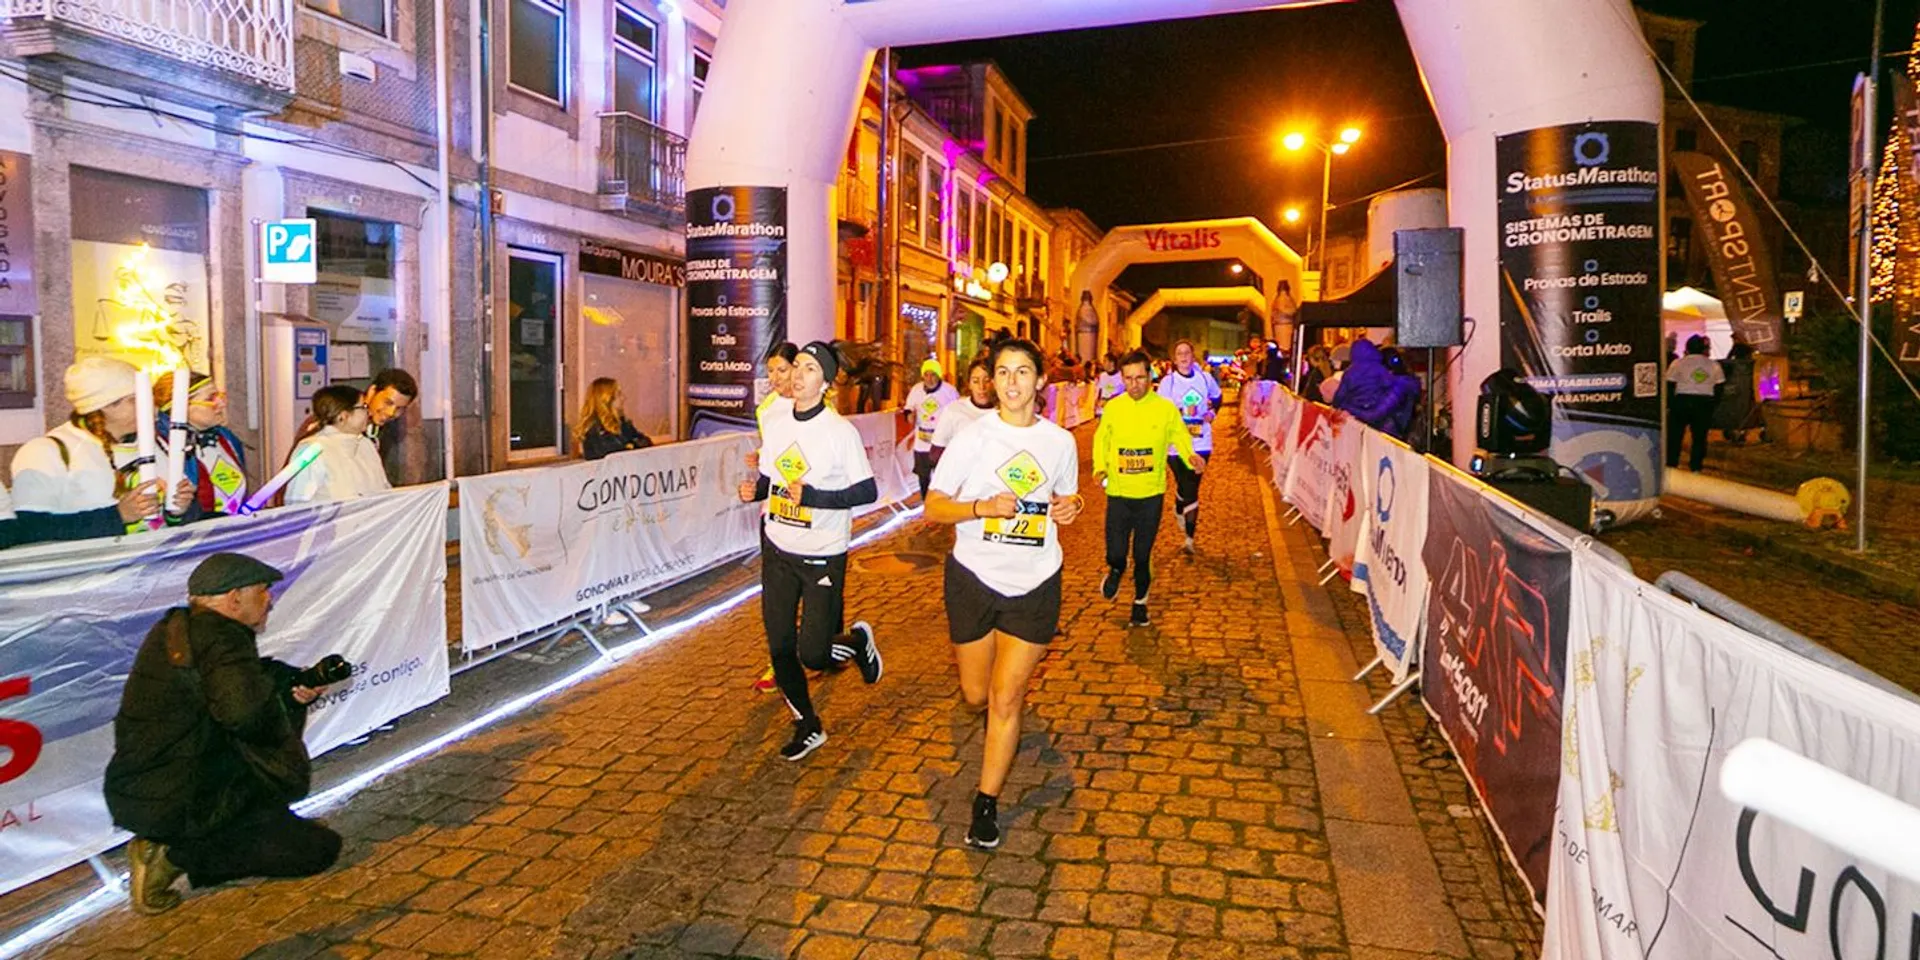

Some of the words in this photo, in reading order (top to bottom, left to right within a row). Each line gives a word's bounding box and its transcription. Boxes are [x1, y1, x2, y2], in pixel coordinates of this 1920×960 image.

[1505, 166, 1658, 194] StatusMarathon
[686, 221, 785, 239] StatusMarathon
[1505, 214, 1582, 234] SISTEMAS
[1584, 213, 1605, 226] DE
[269, 225, 289, 257] P
[1144, 228, 1221, 251] Vitalis
[1505, 225, 1654, 248] CRONOMETRAGEM
[717, 258, 732, 269] DE
[1524, 276, 1577, 291] Provas
[1578, 272, 1599, 287] de
[1601, 271, 1649, 285] Estrada
[714, 305, 728, 317] de
[728, 305, 769, 317] Estrada
[1571, 309, 1612, 324] Trails
[1551, 344, 1594, 358] Corta
[1596, 342, 1632, 356] Mato
[724, 361, 752, 372] Mato
[576, 465, 698, 513] GONDOMAR
[1567, 841, 1589, 865] DE
